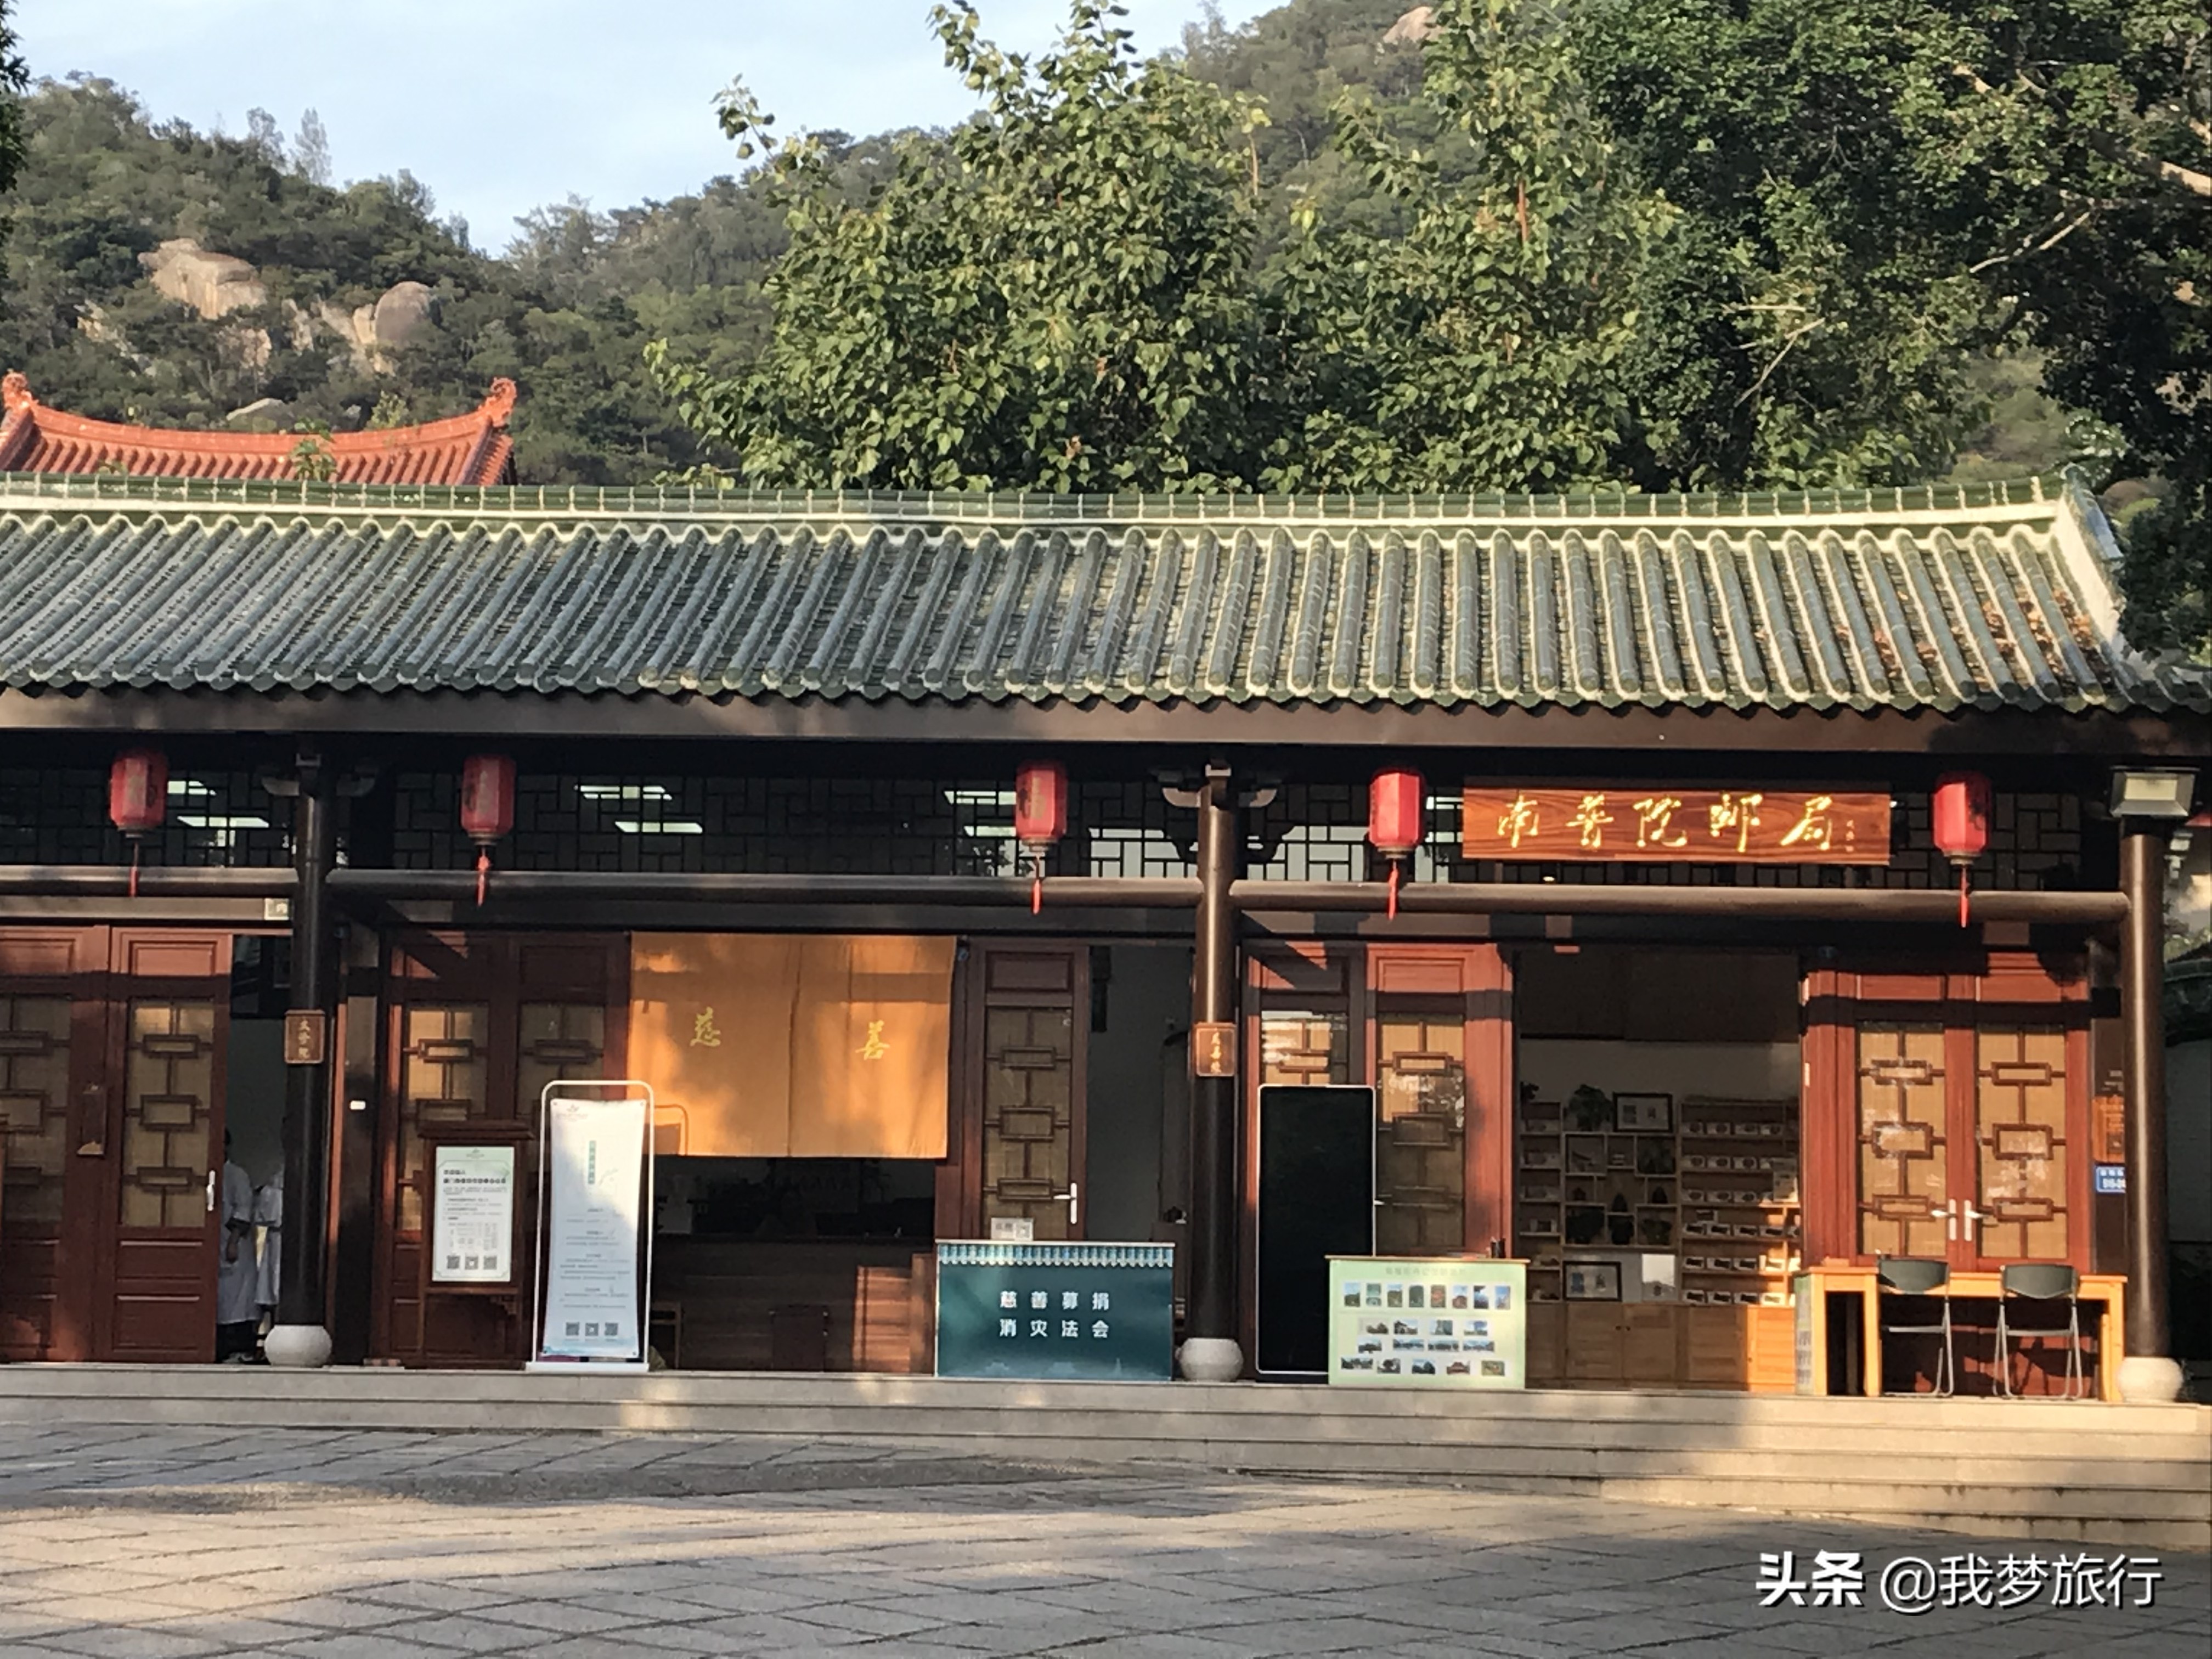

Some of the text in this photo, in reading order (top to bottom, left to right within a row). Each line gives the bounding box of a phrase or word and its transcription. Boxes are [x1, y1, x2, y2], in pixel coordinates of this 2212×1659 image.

[1000, 1290, 1109, 1311] 慈善募捐
[1000, 1318, 1109, 1339] 消灾法会
